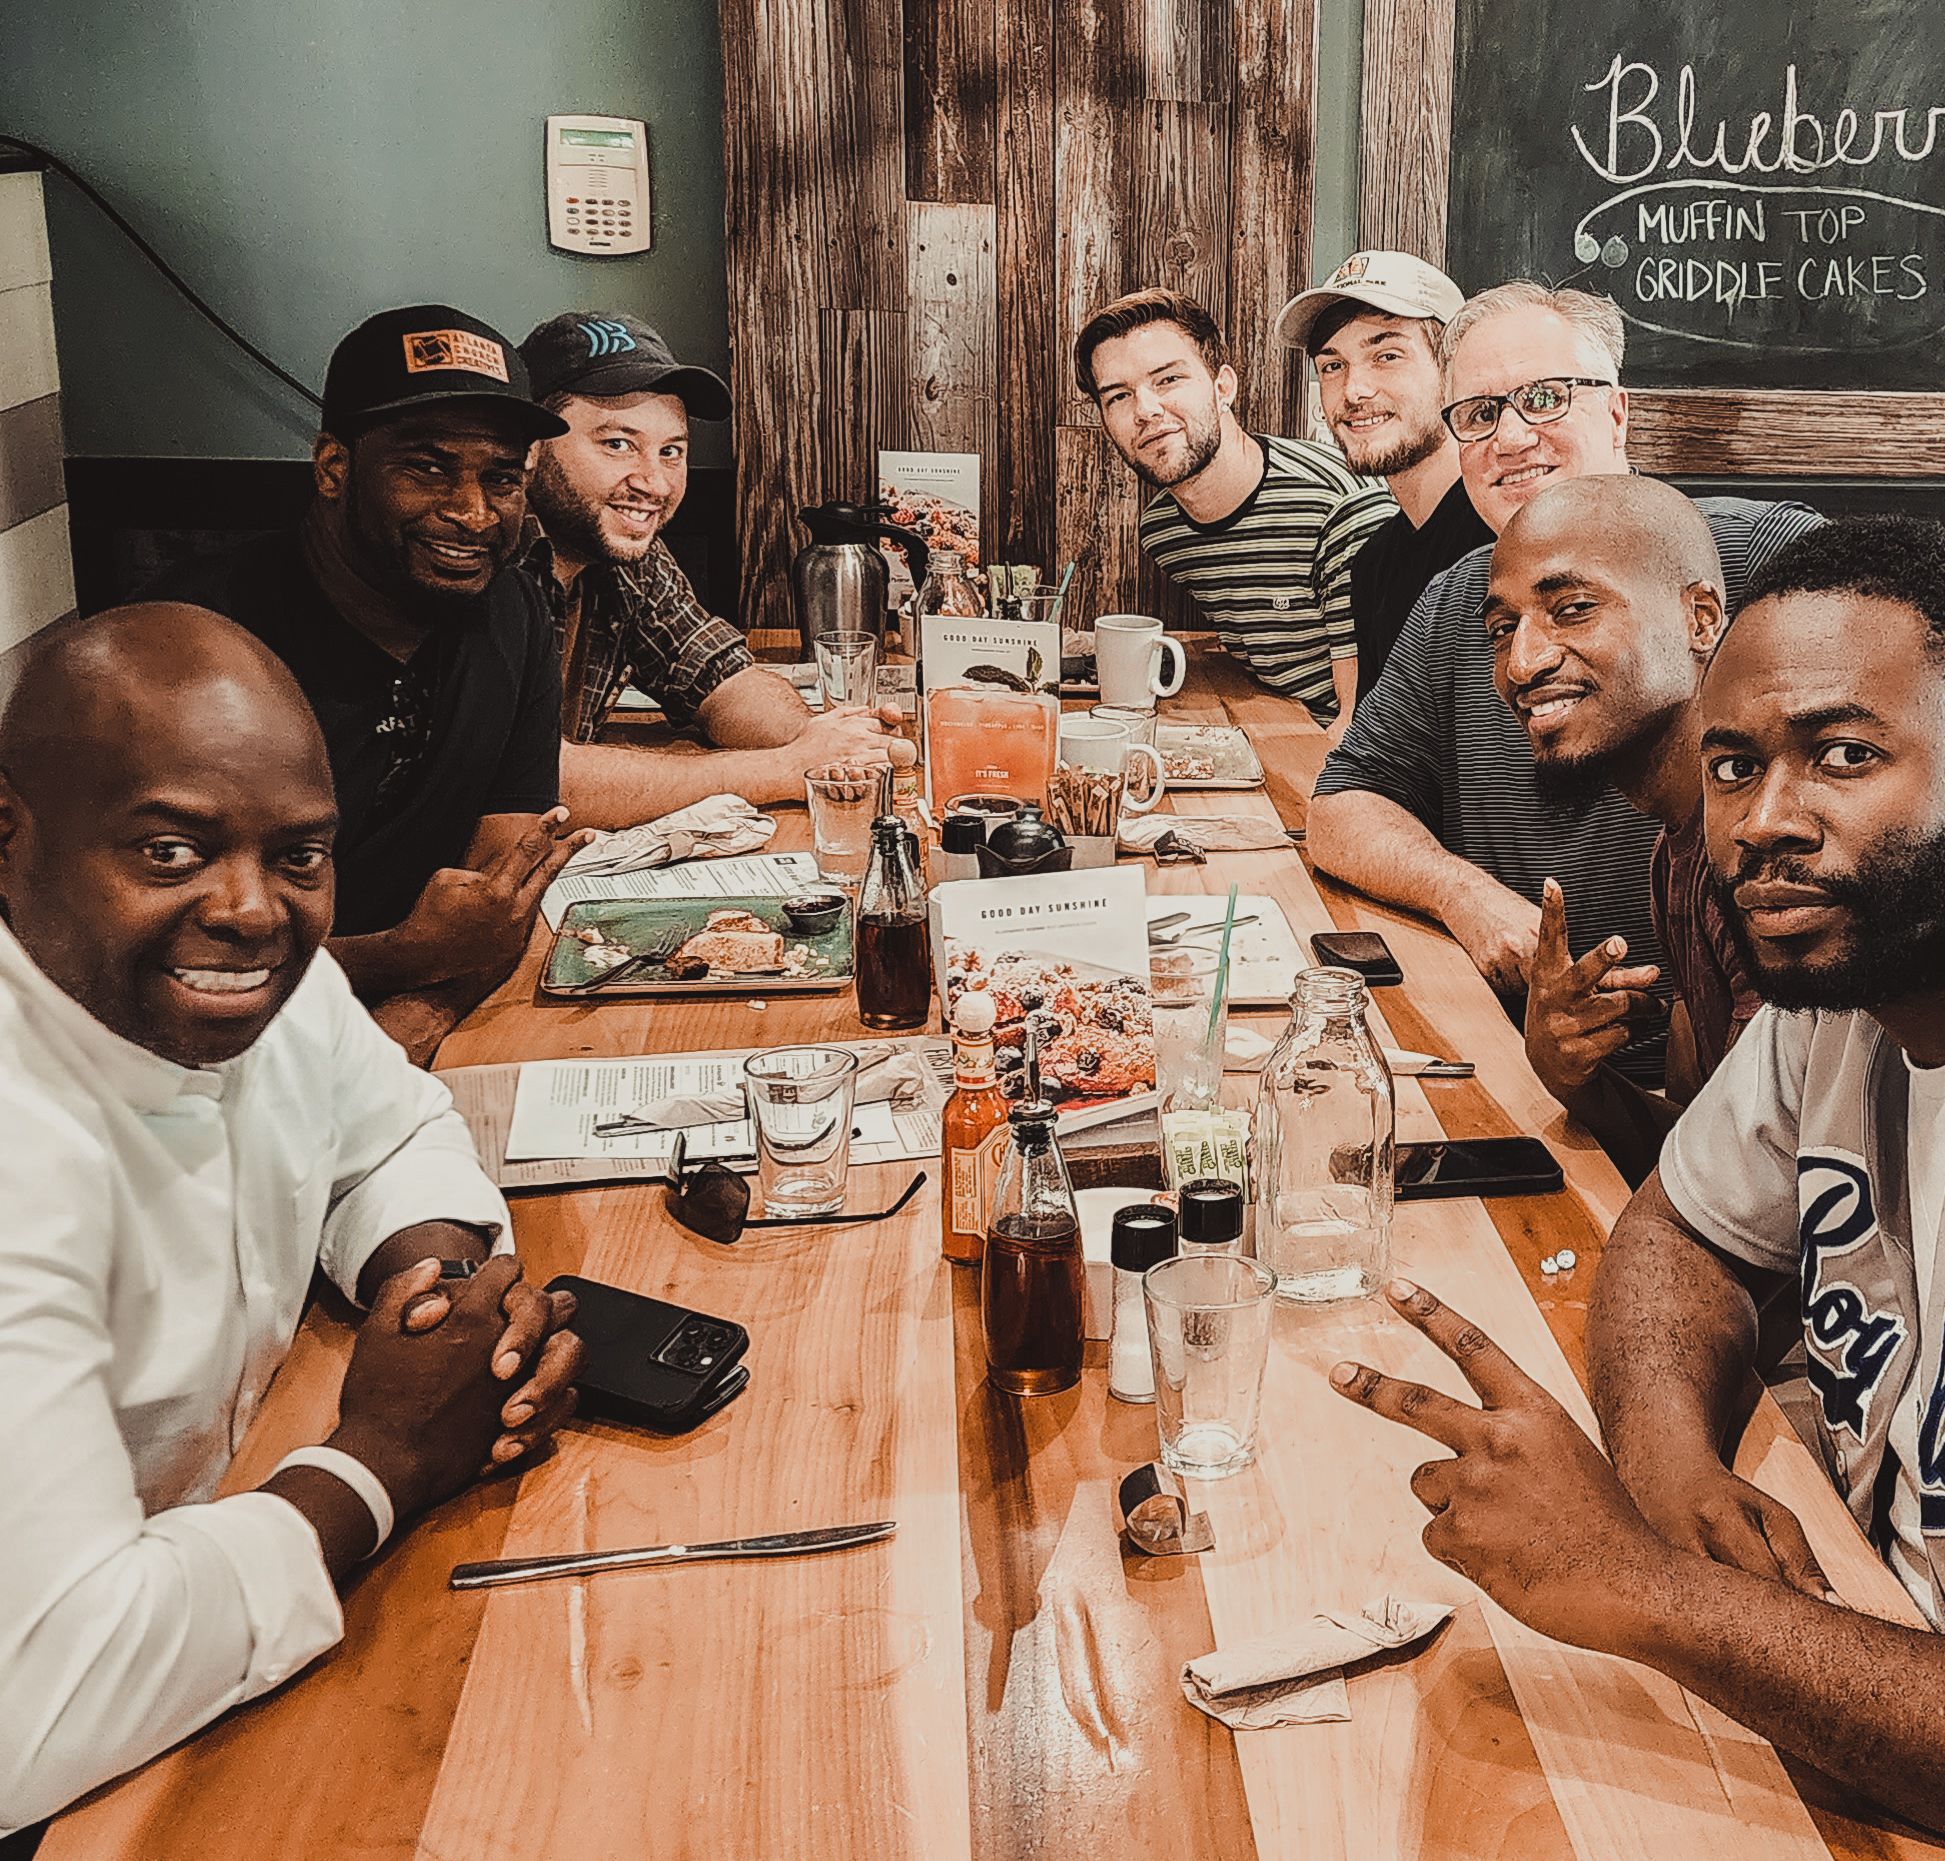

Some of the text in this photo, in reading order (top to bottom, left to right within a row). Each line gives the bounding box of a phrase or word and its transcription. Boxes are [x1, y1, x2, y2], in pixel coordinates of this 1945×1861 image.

[1638, 200, 1866, 244] MUFFIN TOP
[1636, 254, 1928, 303] GRIDDLE CAKES
[943, 634, 966, 642] GOOD
[993, 637, 1037, 647] SUNSHINE
[981, 898, 1107, 919] GOOD DAY SUNSHINE
[923, 1049, 954, 1070] FIRST
